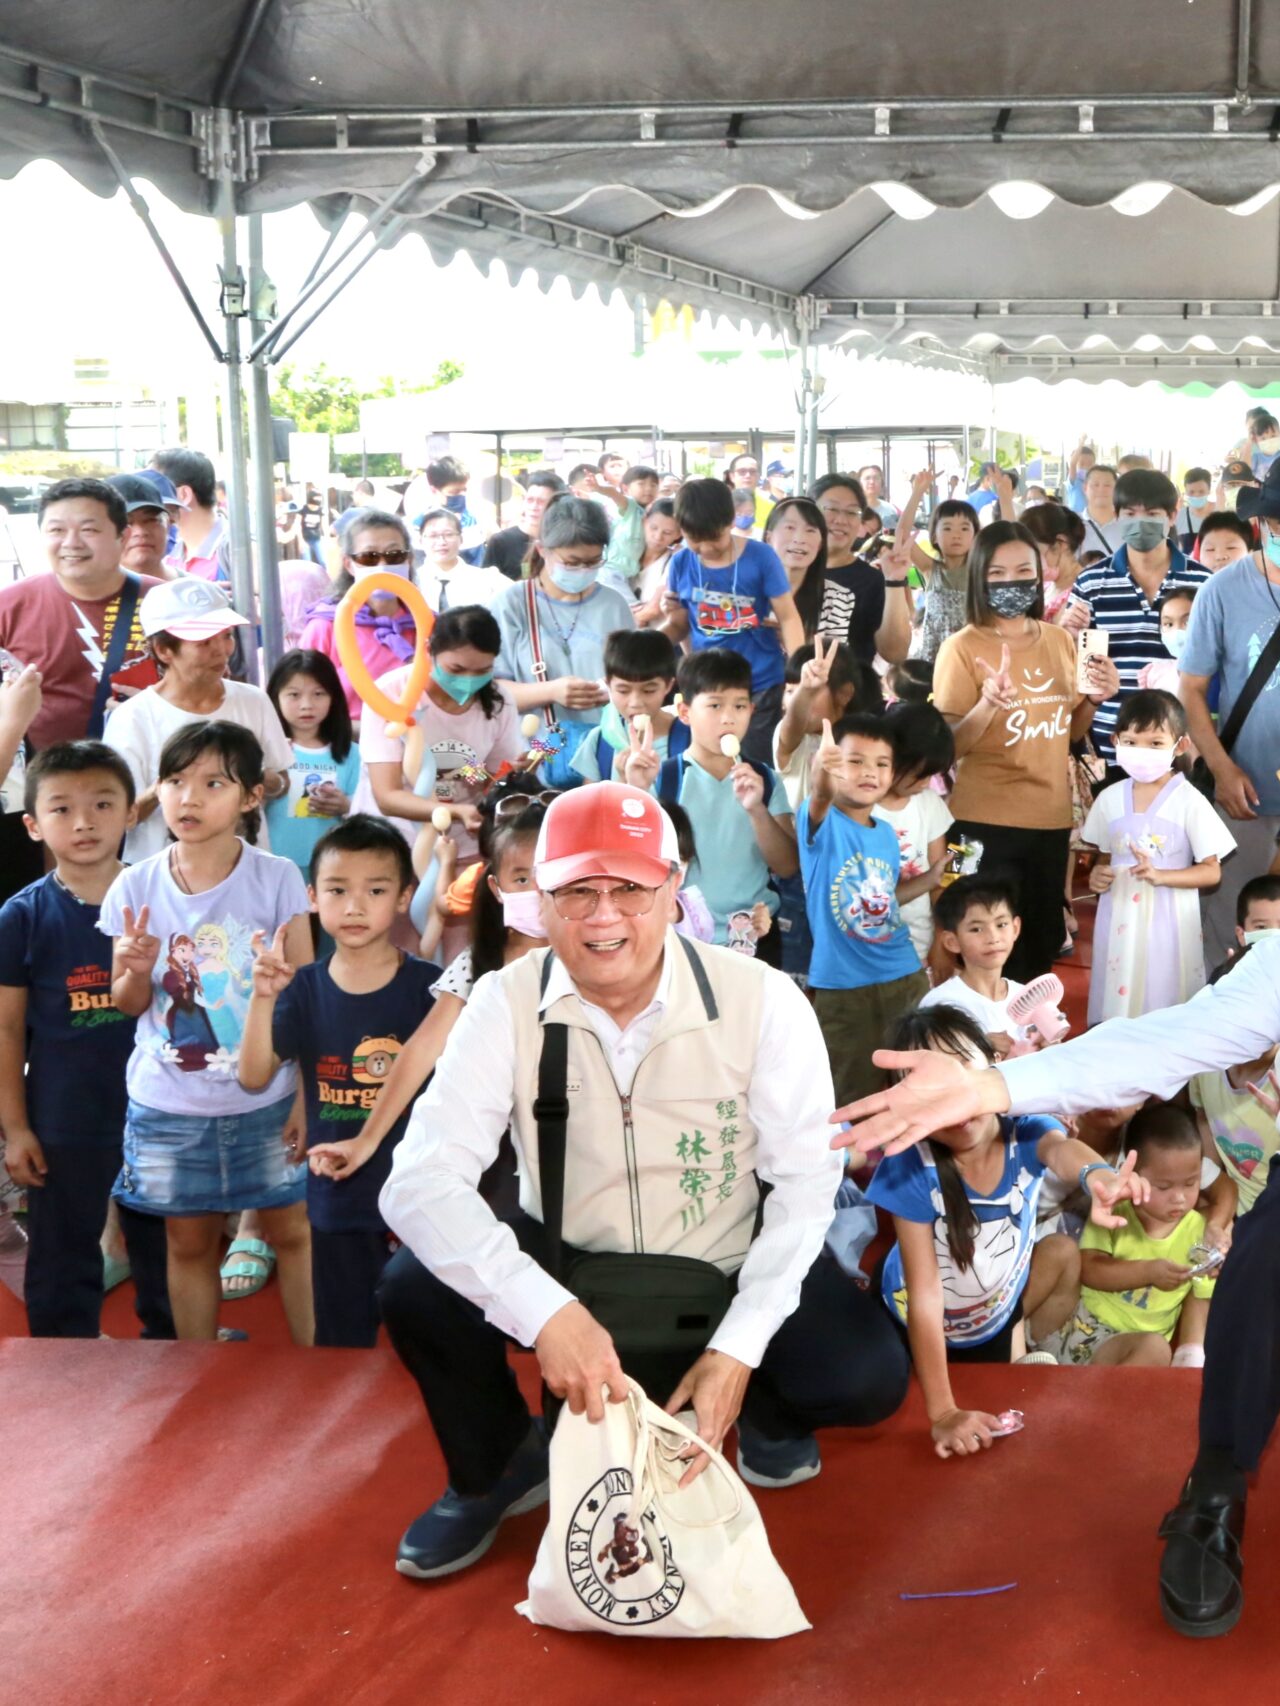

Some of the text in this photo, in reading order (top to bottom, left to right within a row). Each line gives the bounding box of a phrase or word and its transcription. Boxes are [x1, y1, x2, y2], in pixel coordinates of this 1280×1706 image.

[318, 1081, 378, 1109] Burg
[675, 1129, 712, 1232] 林榮川
[570, 1521, 617, 1618] MONKEY
